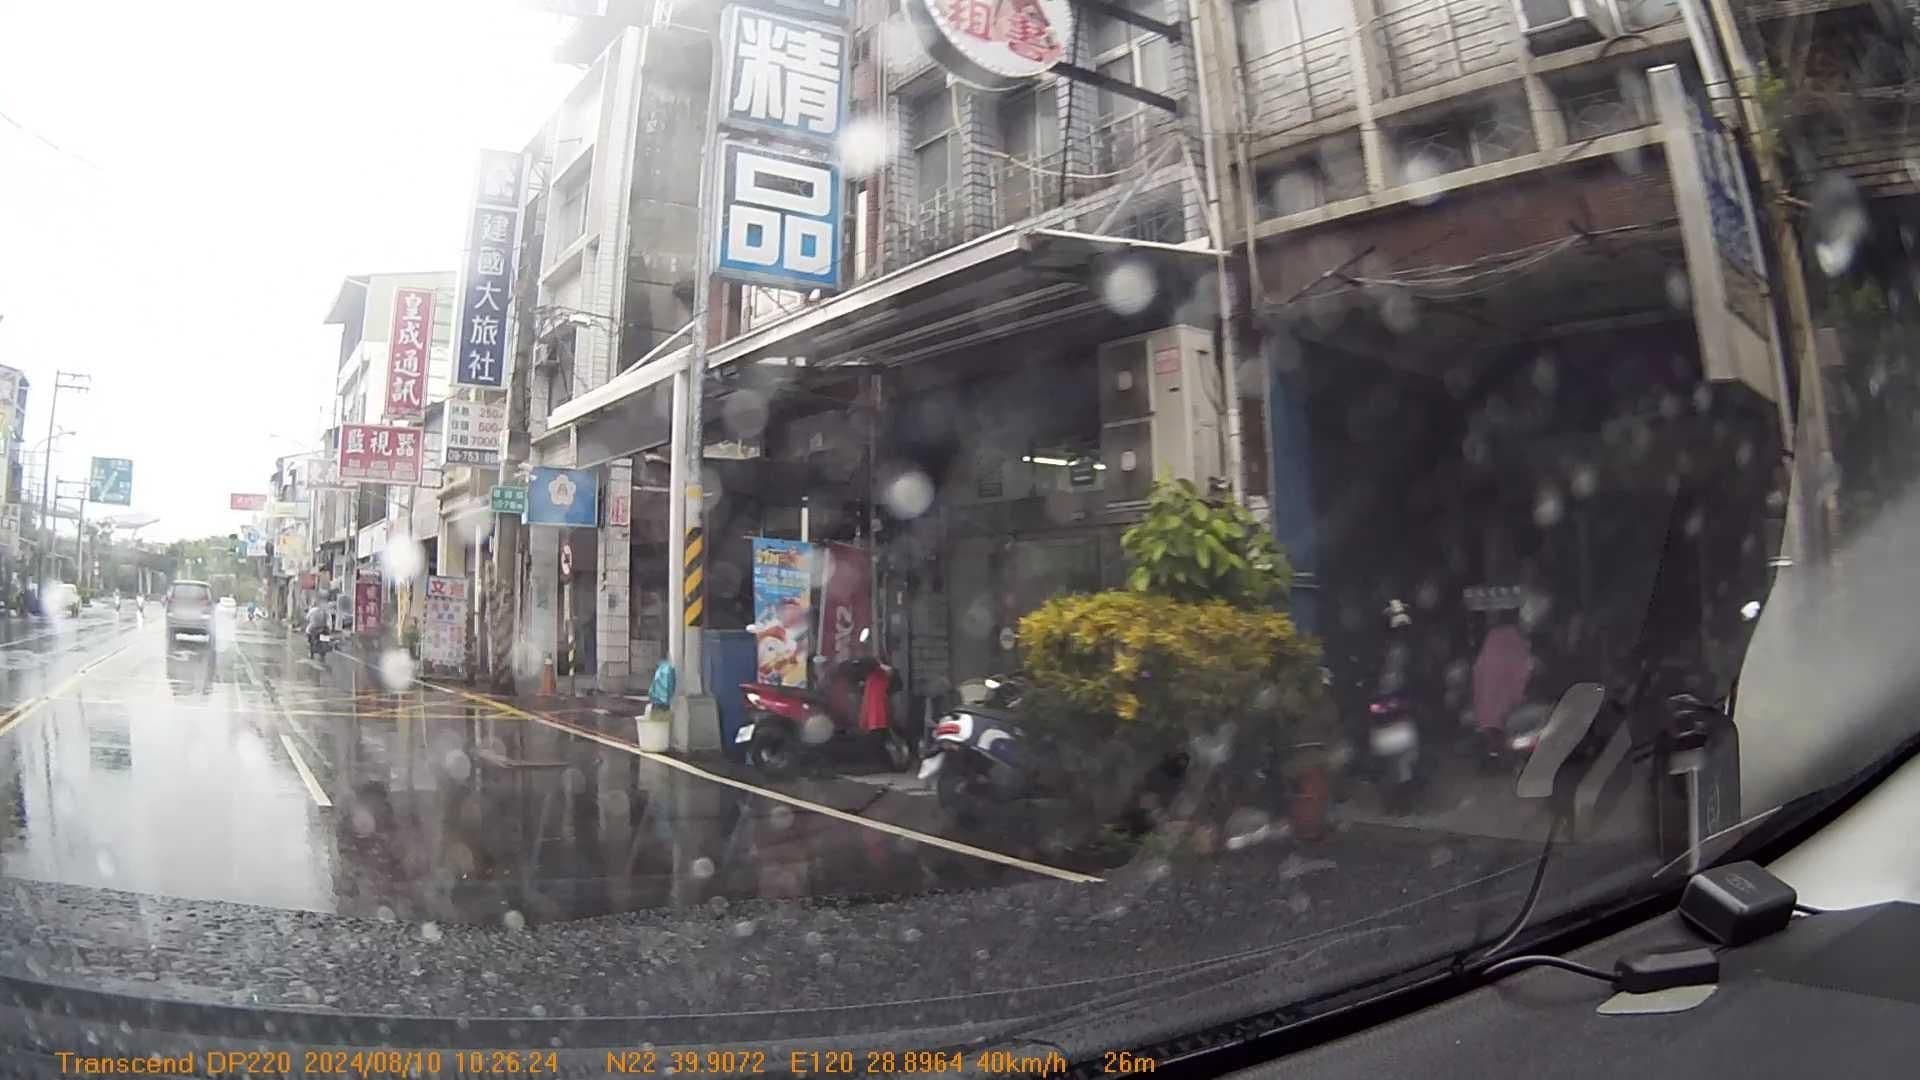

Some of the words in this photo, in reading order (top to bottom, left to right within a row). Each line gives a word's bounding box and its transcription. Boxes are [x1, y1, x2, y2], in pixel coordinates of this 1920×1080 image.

[728, 17, 840, 276] 精品
[392, 293, 424, 406] 皇成通訊
[468, 213, 510, 382] 建國大旅社
[346, 428, 416, 457] 監視器
